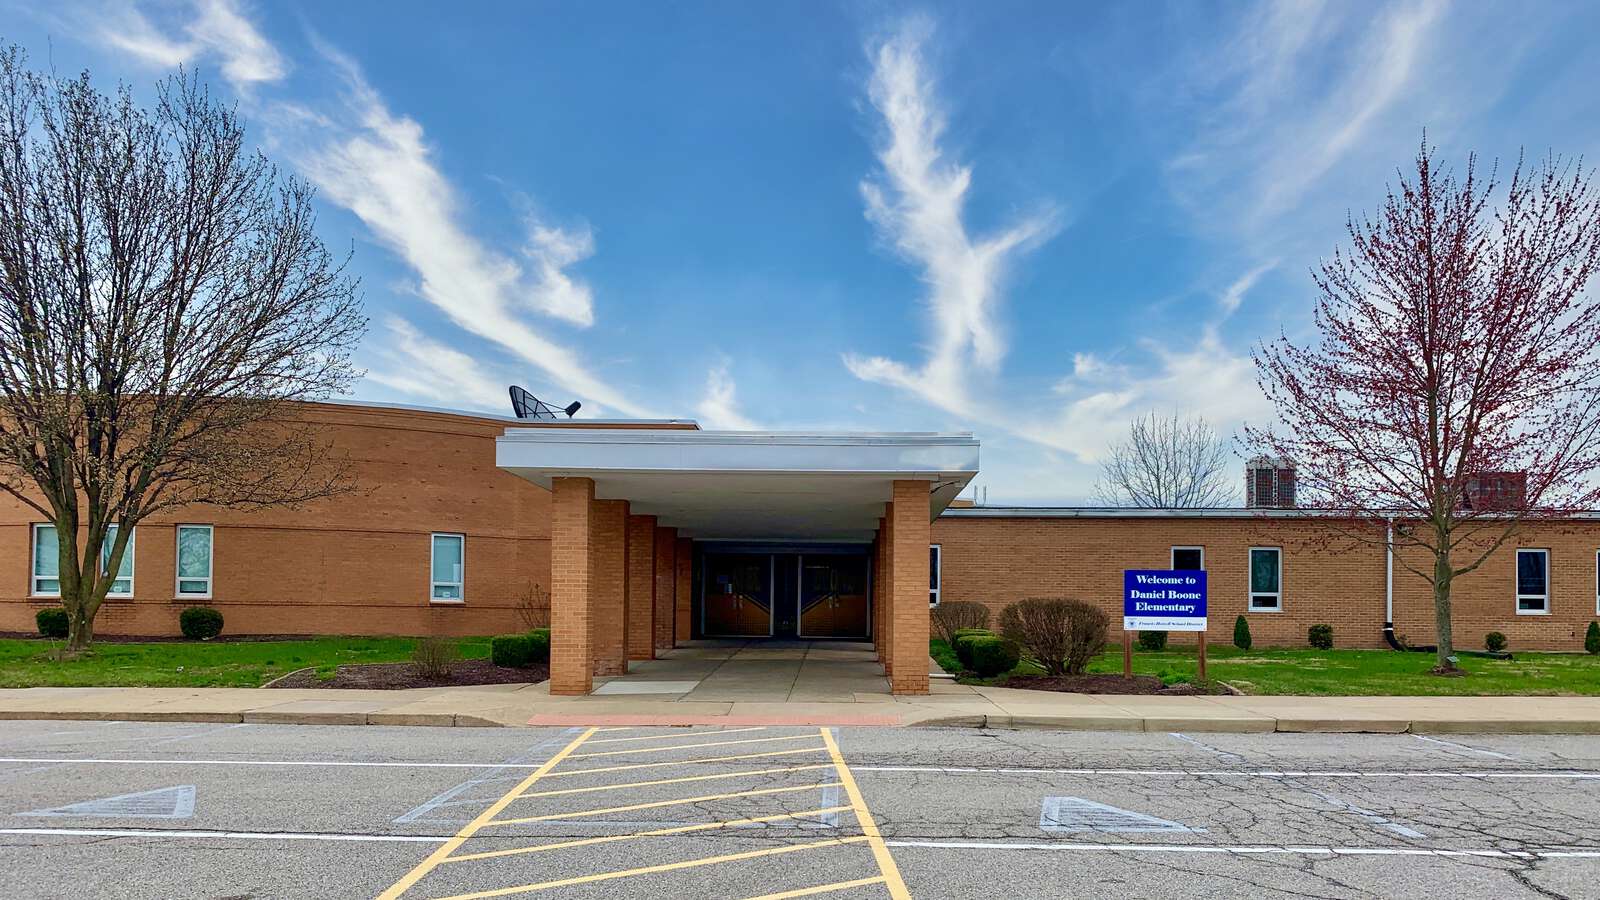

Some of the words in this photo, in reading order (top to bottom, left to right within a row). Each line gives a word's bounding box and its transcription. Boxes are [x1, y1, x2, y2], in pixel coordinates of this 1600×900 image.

[1136, 575, 1183, 584] Welcome
[1185, 576, 1196, 584] to
[1130, 590, 1165, 599] Daniel
[1168, 590, 1201, 599] Boone
[1135, 602, 1196, 613] Elementary
